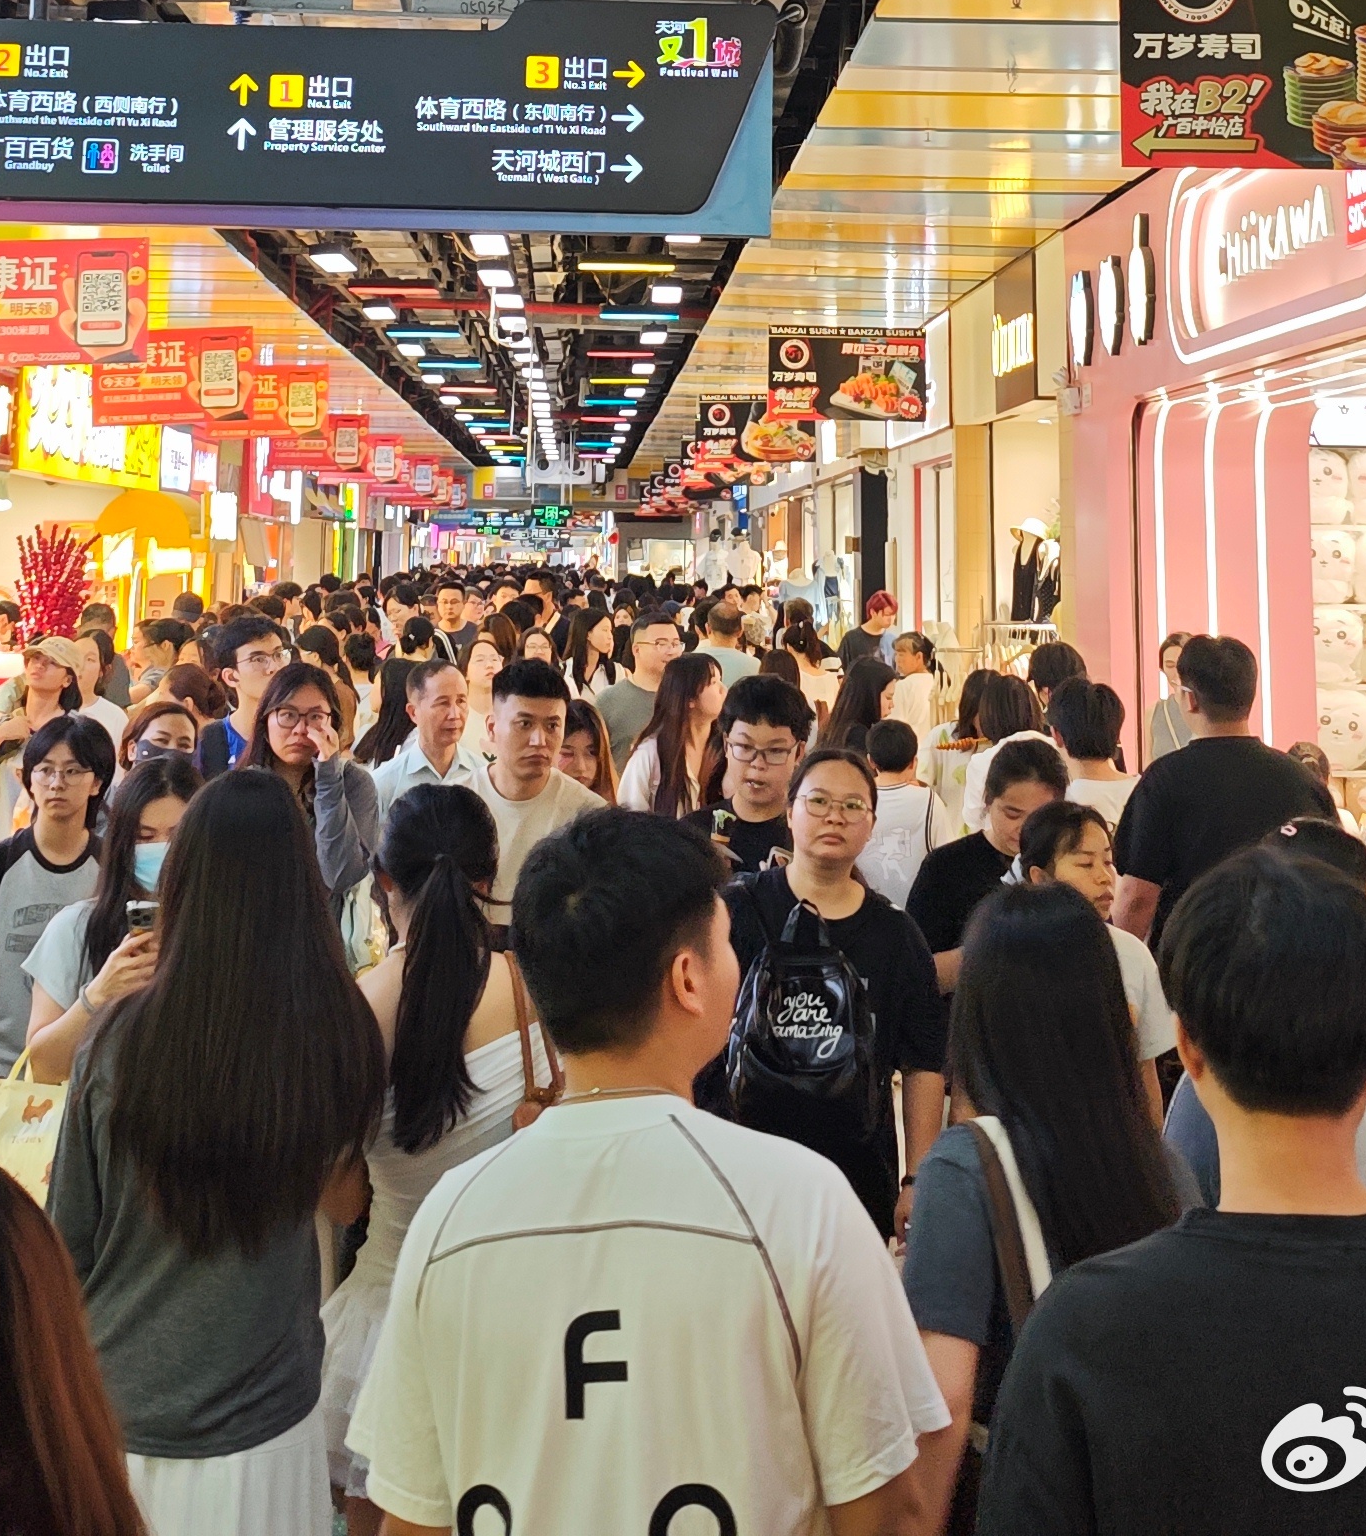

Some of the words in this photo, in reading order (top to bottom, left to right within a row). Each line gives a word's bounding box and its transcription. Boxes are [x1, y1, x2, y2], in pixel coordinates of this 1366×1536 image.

[655, 20, 686, 34] 天河
[1133, 33, 1262, 60] 万岁寿司
[25, 44, 70, 66] 出口
[24, 68, 48, 78] No.2
[49, 68, 68, 79] Exit
[534, 61, 550, 84] 3
[564, 56, 608, 80] 出口
[659, 67, 709, 78] Festival
[711, 68, 739, 78] Walk
[280, 80, 293, 102] 1
[308, 75, 353, 98] 出口
[564, 80, 586, 90] No.3
[589, 81, 607, 91] Exit
[307, 99, 331, 109] No.1
[333, 100, 352, 110] Exit
[1140, 78, 1265, 117] 我在B2!
[40, 115, 56, 126] the
[58, 115, 102, 126] Westside
[103, 116, 115, 127] of
[116, 116, 125, 127] Ti
[126, 117, 139, 128] Yu
[140, 117, 150, 127] Xi
[151, 117, 177, 128] Road
[416, 121, 470, 133] Southward
[472, 122, 488, 133] the
[490, 123, 530, 134] Eastside
[532, 124, 543, 135] of
[545, 124, 553, 135] Ti
[555, 125, 567, 135] Yu
[569, 125, 579, 135] Xi
[581, 125, 606, 136] Road
[1157, 116, 1245, 139] 广百中怡店
[268, 118, 384, 143] 管理服务处
[129, 143, 184, 163] 洗手间
[263, 141, 309, 154] Property
[310, 142, 349, 152] Service
[350, 143, 386, 154] Center
[4, 160, 55, 172] Grandbuy
[491, 149, 605, 173] 天河城西门
[141, 163, 170, 174] Toilet
[497, 172, 534, 183] Teemall
[10, 302, 52, 316] 明天领
[771, 327, 806, 335] BANZAI
[792, 1006, 832, 1024] are
[772, 1023, 843, 1059] amazing
